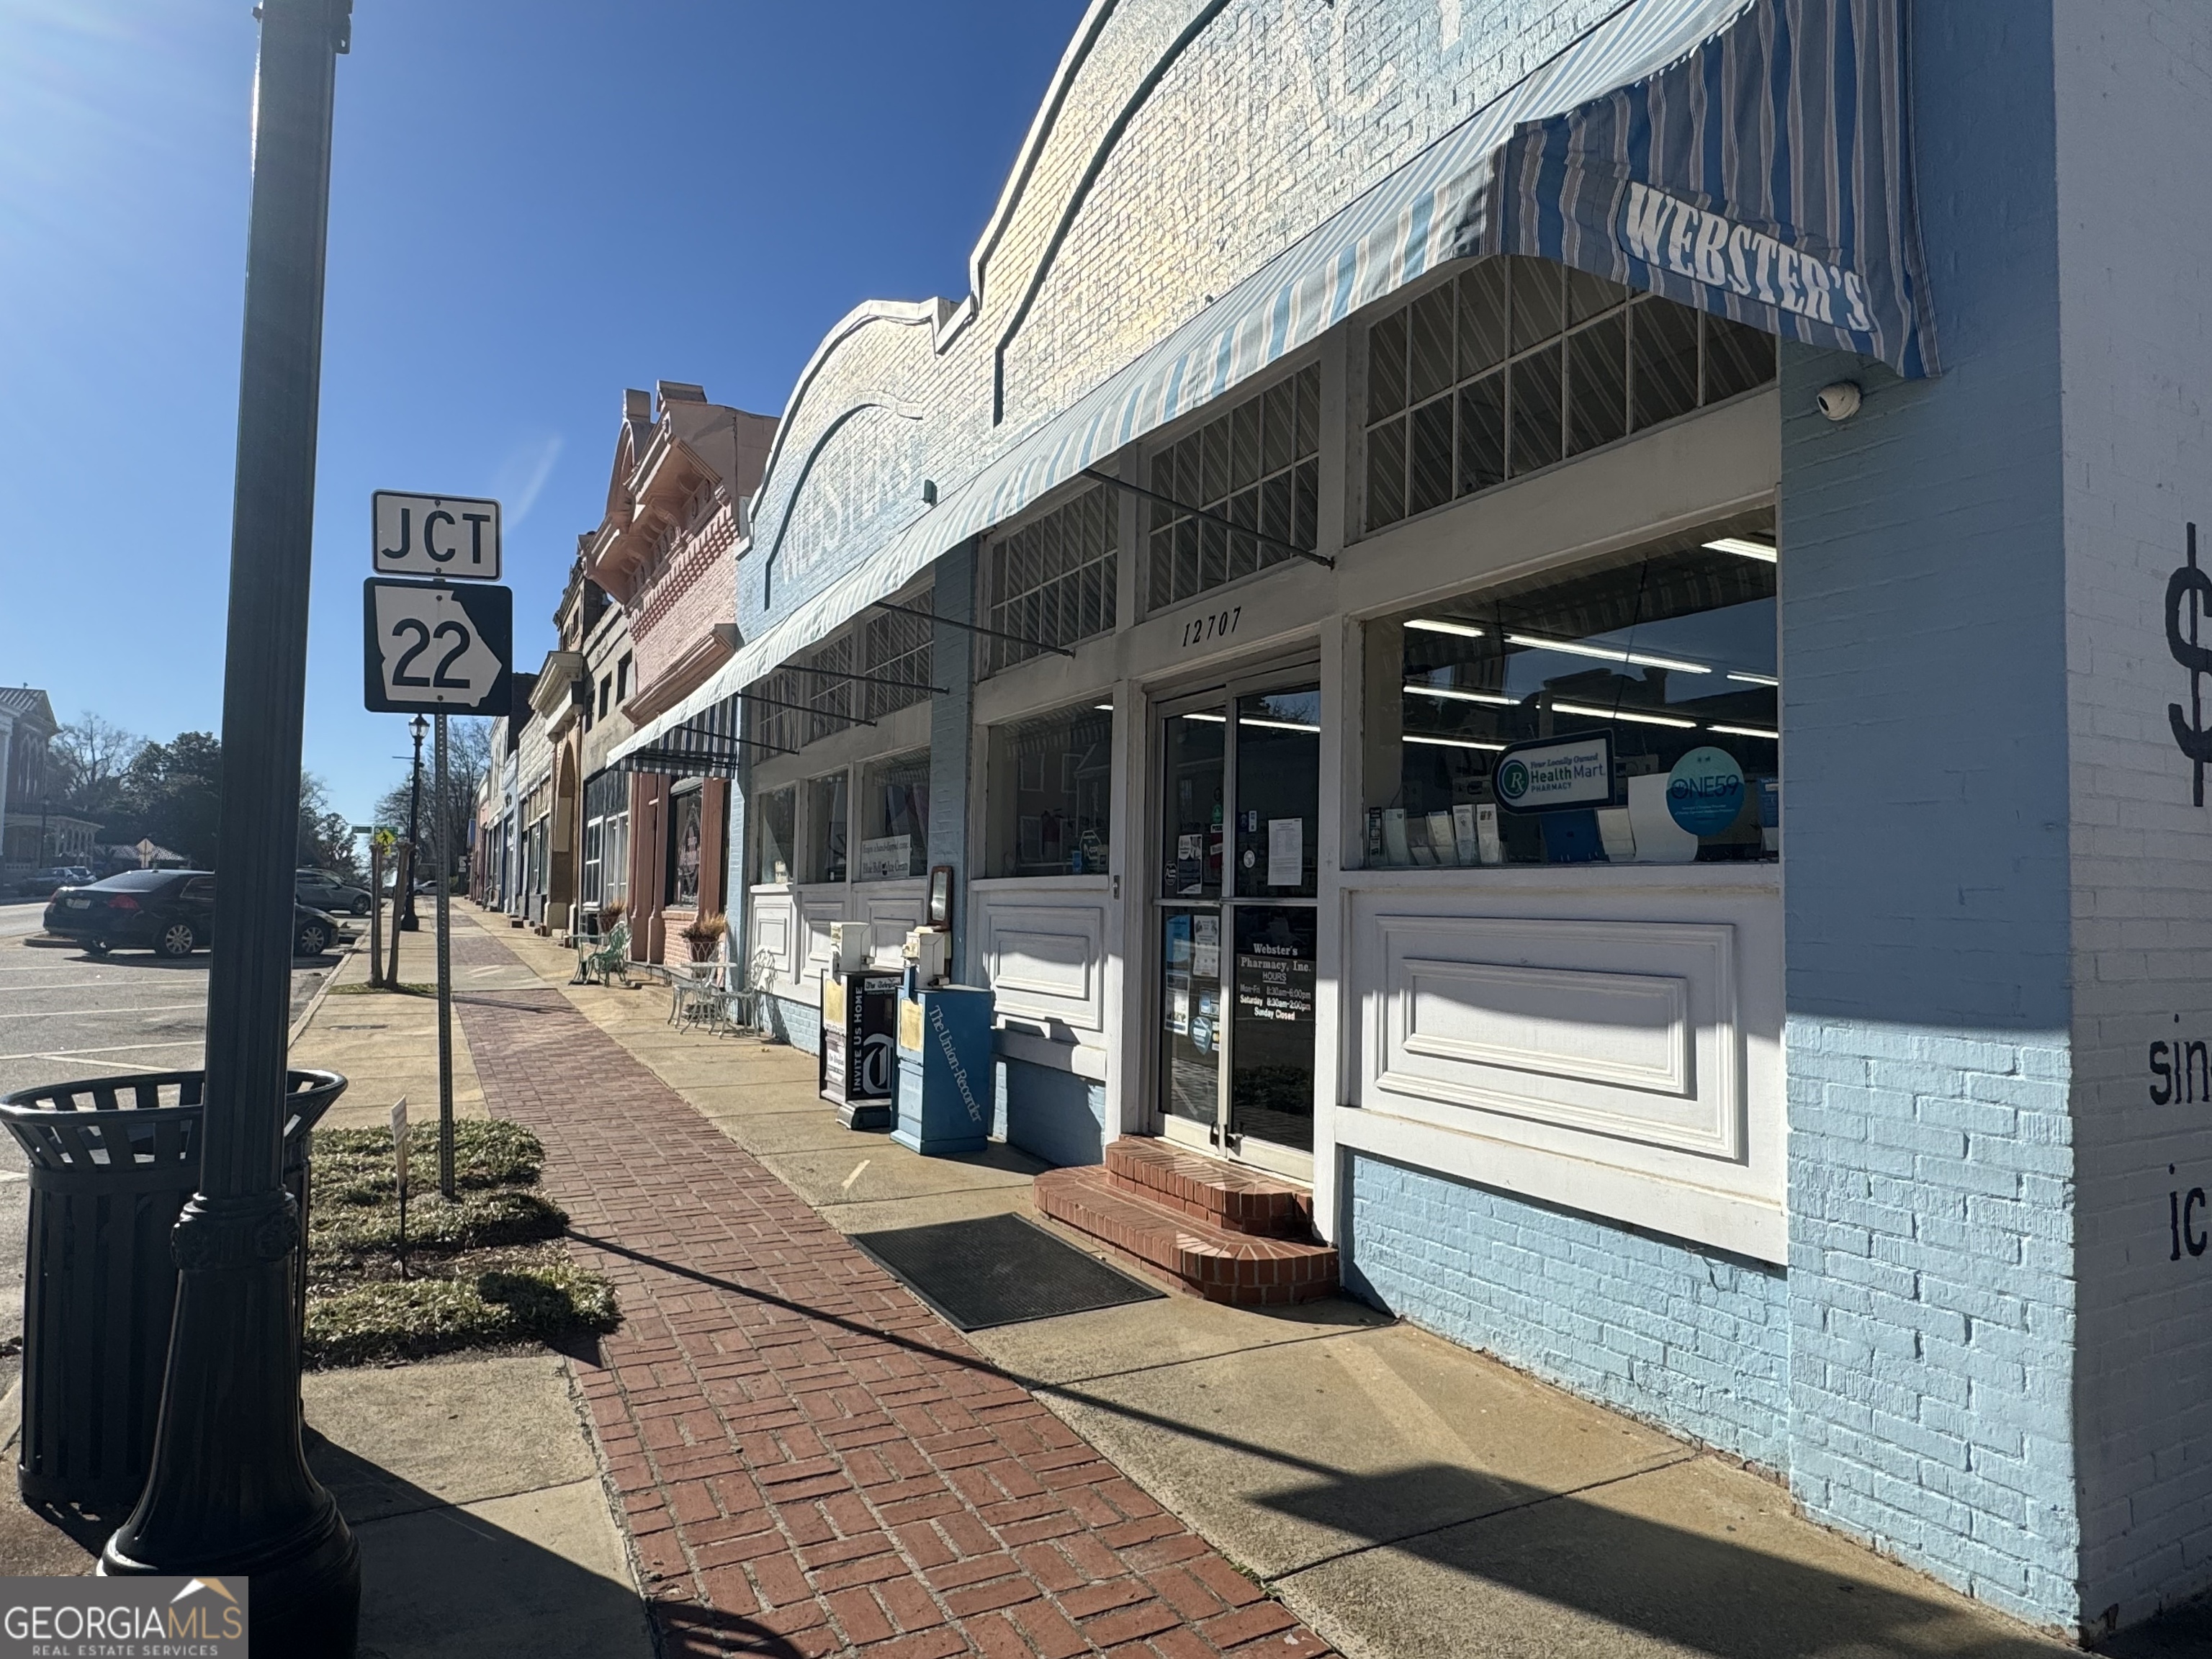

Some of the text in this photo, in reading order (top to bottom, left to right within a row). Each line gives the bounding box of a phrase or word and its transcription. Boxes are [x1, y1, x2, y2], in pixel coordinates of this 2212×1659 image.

[1626, 180, 1874, 332] WEBSTER'S
[381, 508, 491, 565] JCT
[1182, 606, 1241, 647] 12707
[392, 618, 470, 689] 22
[1547, 757, 1573, 767] Locally
[1573, 752, 1599, 763] Owned
[1531, 763, 1604, 783] Health Mart
[1531, 782, 1572, 793] PHARMACY
[1671, 774, 1740, 800] ONE59
[1253, 943, 1298, 956] Webster's
[1241, 956, 1311, 972] Pharmacy, Inc.
[1262, 971, 1287, 981] HOURS
[1240, 994, 1263, 1007] Saturday
[1254, 1006, 1295, 1020] Sunday Closed
[853, 986, 863, 1092] INVITE US HOME
[929, 1004, 982, 1123] The Union-Recorder
[2149, 1013, 2212, 1106] sin
